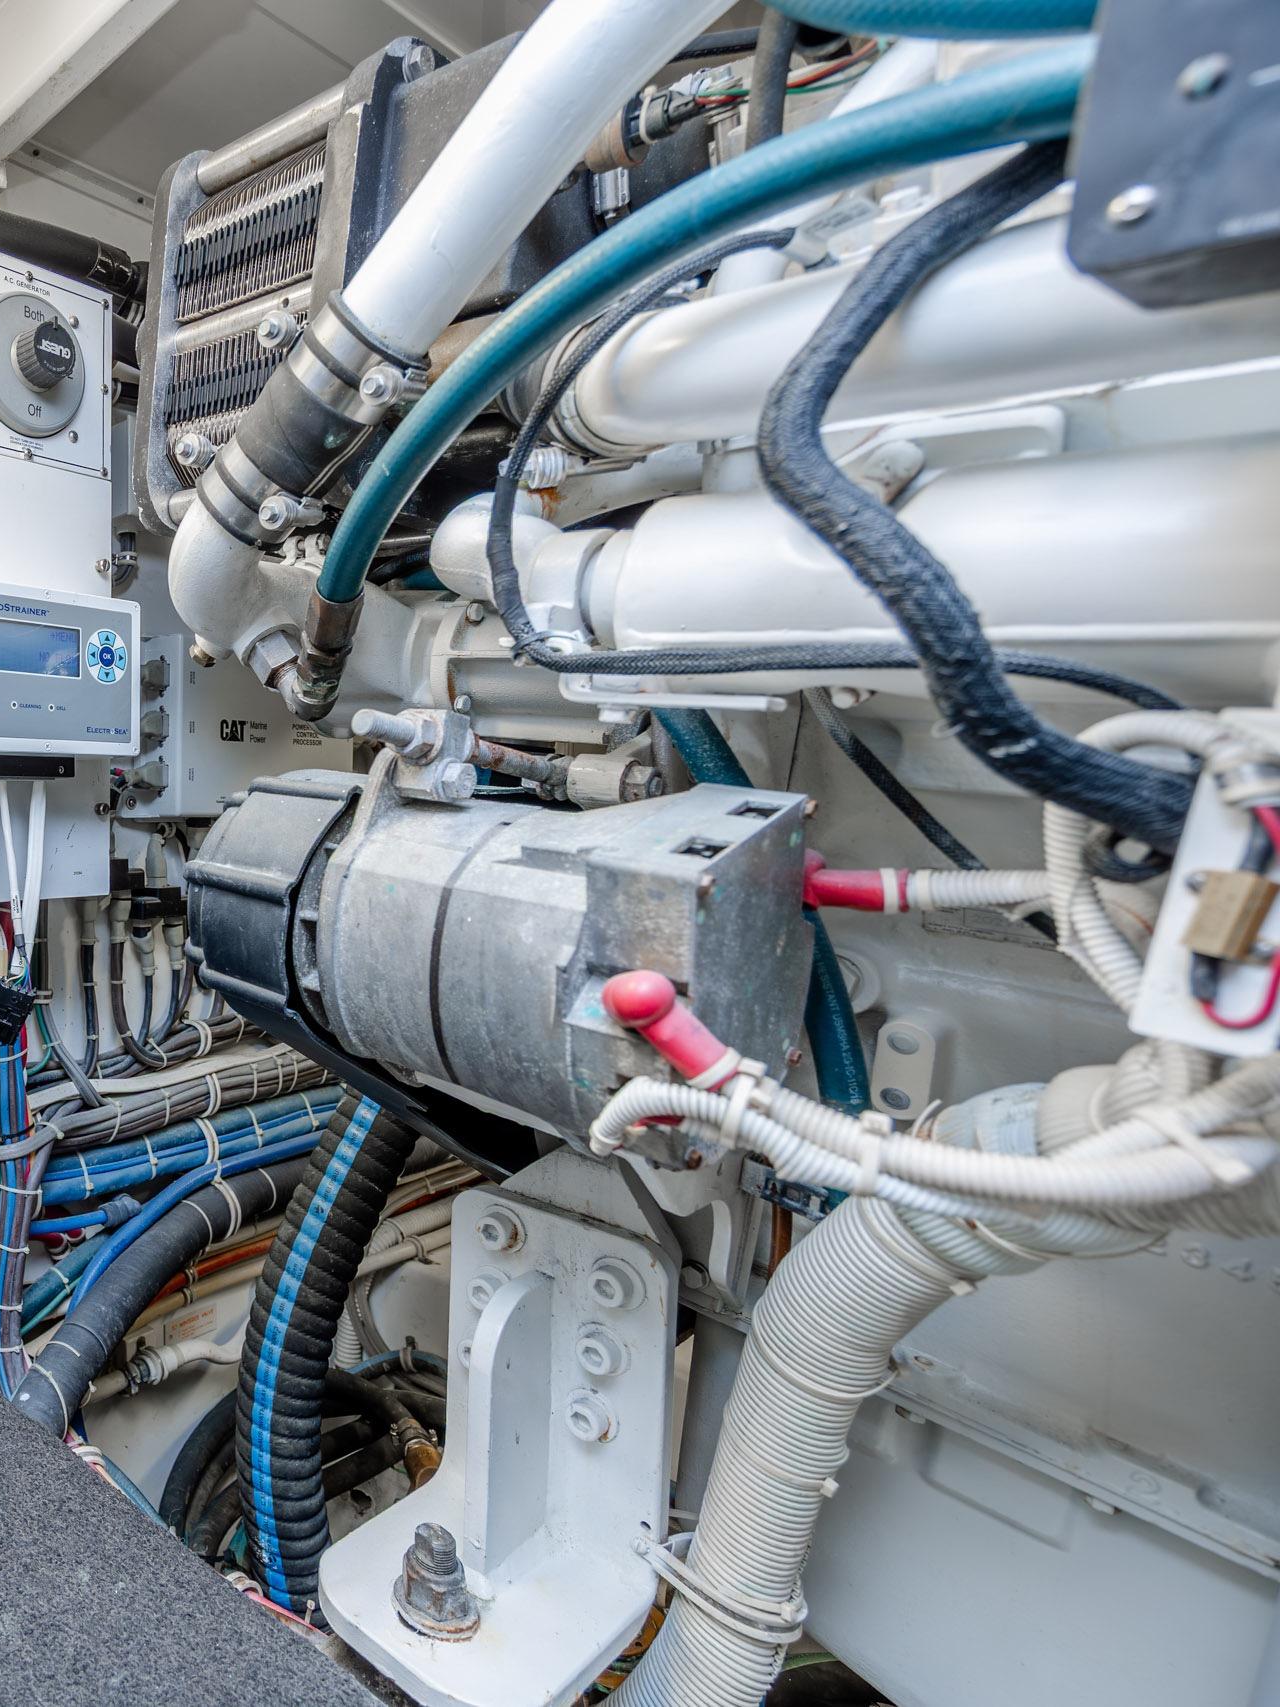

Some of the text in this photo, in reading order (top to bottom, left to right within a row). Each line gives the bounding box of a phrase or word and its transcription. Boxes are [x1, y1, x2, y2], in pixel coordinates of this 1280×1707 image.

[15, 279, 51, 298] GENERATOR
[24, 305, 46, 322] Both
[27, 403, 43, 419] Off
[102, 652, 112, 660] OK
[220, 719, 268, 742] CAT Marine
[249, 734, 267, 744] Power
